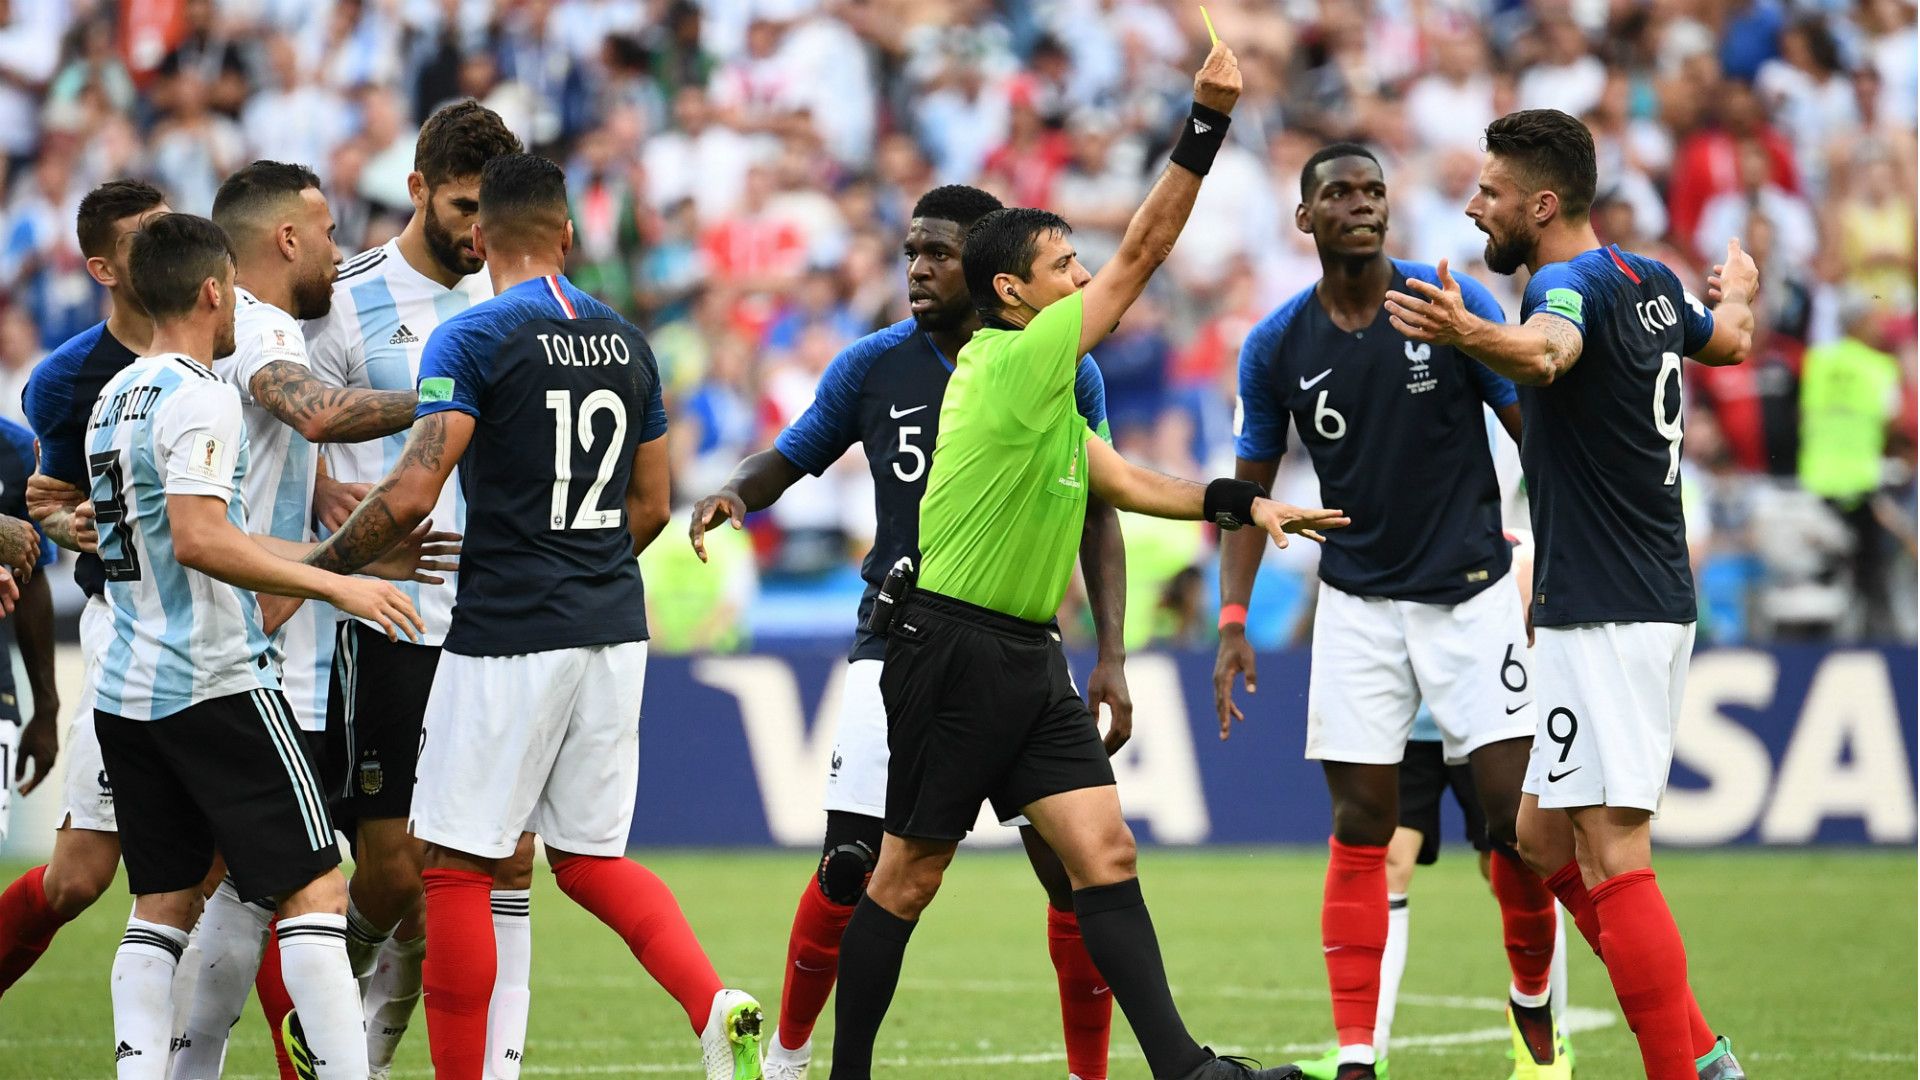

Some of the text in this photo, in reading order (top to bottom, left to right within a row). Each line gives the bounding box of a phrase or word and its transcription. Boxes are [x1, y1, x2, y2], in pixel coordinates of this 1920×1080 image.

[389, 336, 419, 345] adidas
[536, 334, 630, 367] TOLISSO
[1313, 390, 1347, 440] 6
[1653, 352, 1684, 485] 9
[546, 389, 627, 531] 12
[892, 426, 926, 482] 5
[89, 449, 141, 581] 3
[1500, 643, 1528, 693] 6
[692, 654, 1212, 846] VA
[1547, 706, 1578, 763] 9
[1648, 648, 1919, 846] SA
